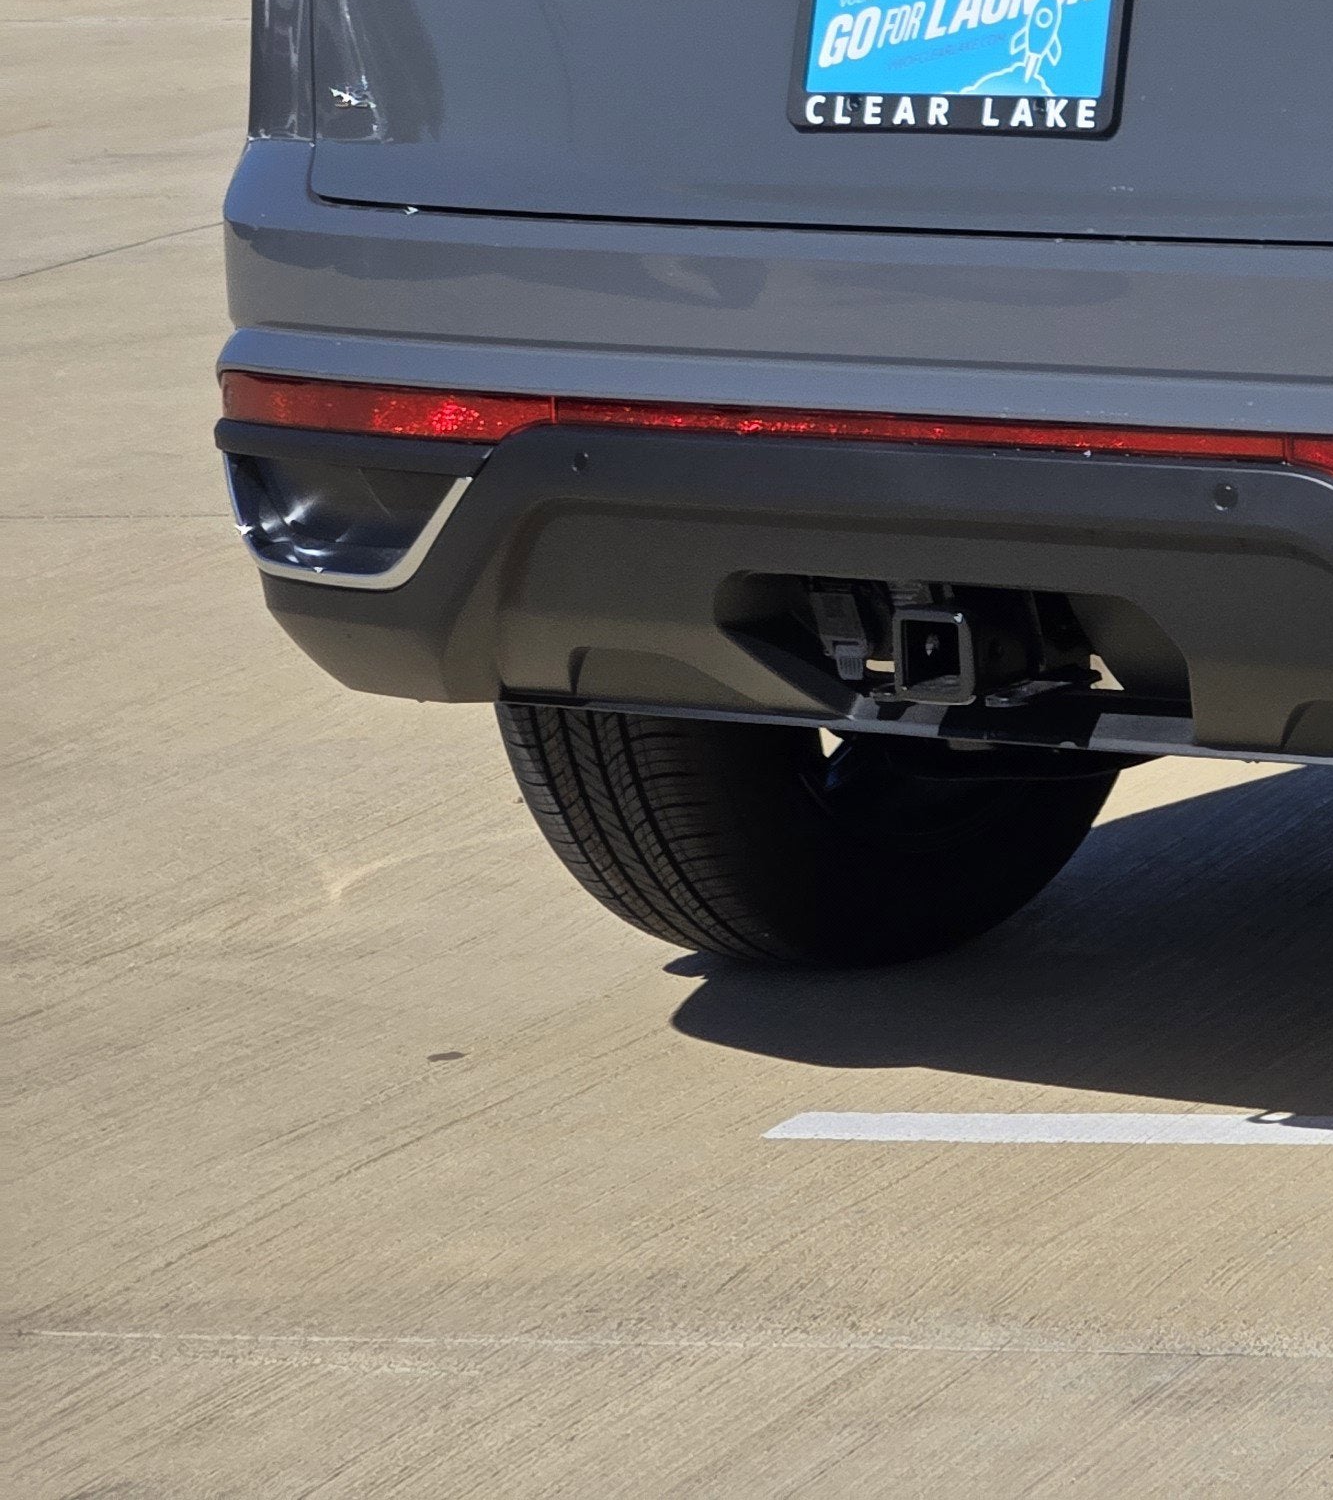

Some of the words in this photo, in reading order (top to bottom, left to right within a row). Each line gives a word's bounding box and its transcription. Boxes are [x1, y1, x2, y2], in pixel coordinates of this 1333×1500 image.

[818, 6, 881, 69] GO
[877, 1, 926, 49] FOR
[805, 96, 950, 127] CLEAR
[981, 97, 1097, 129] LAKE
